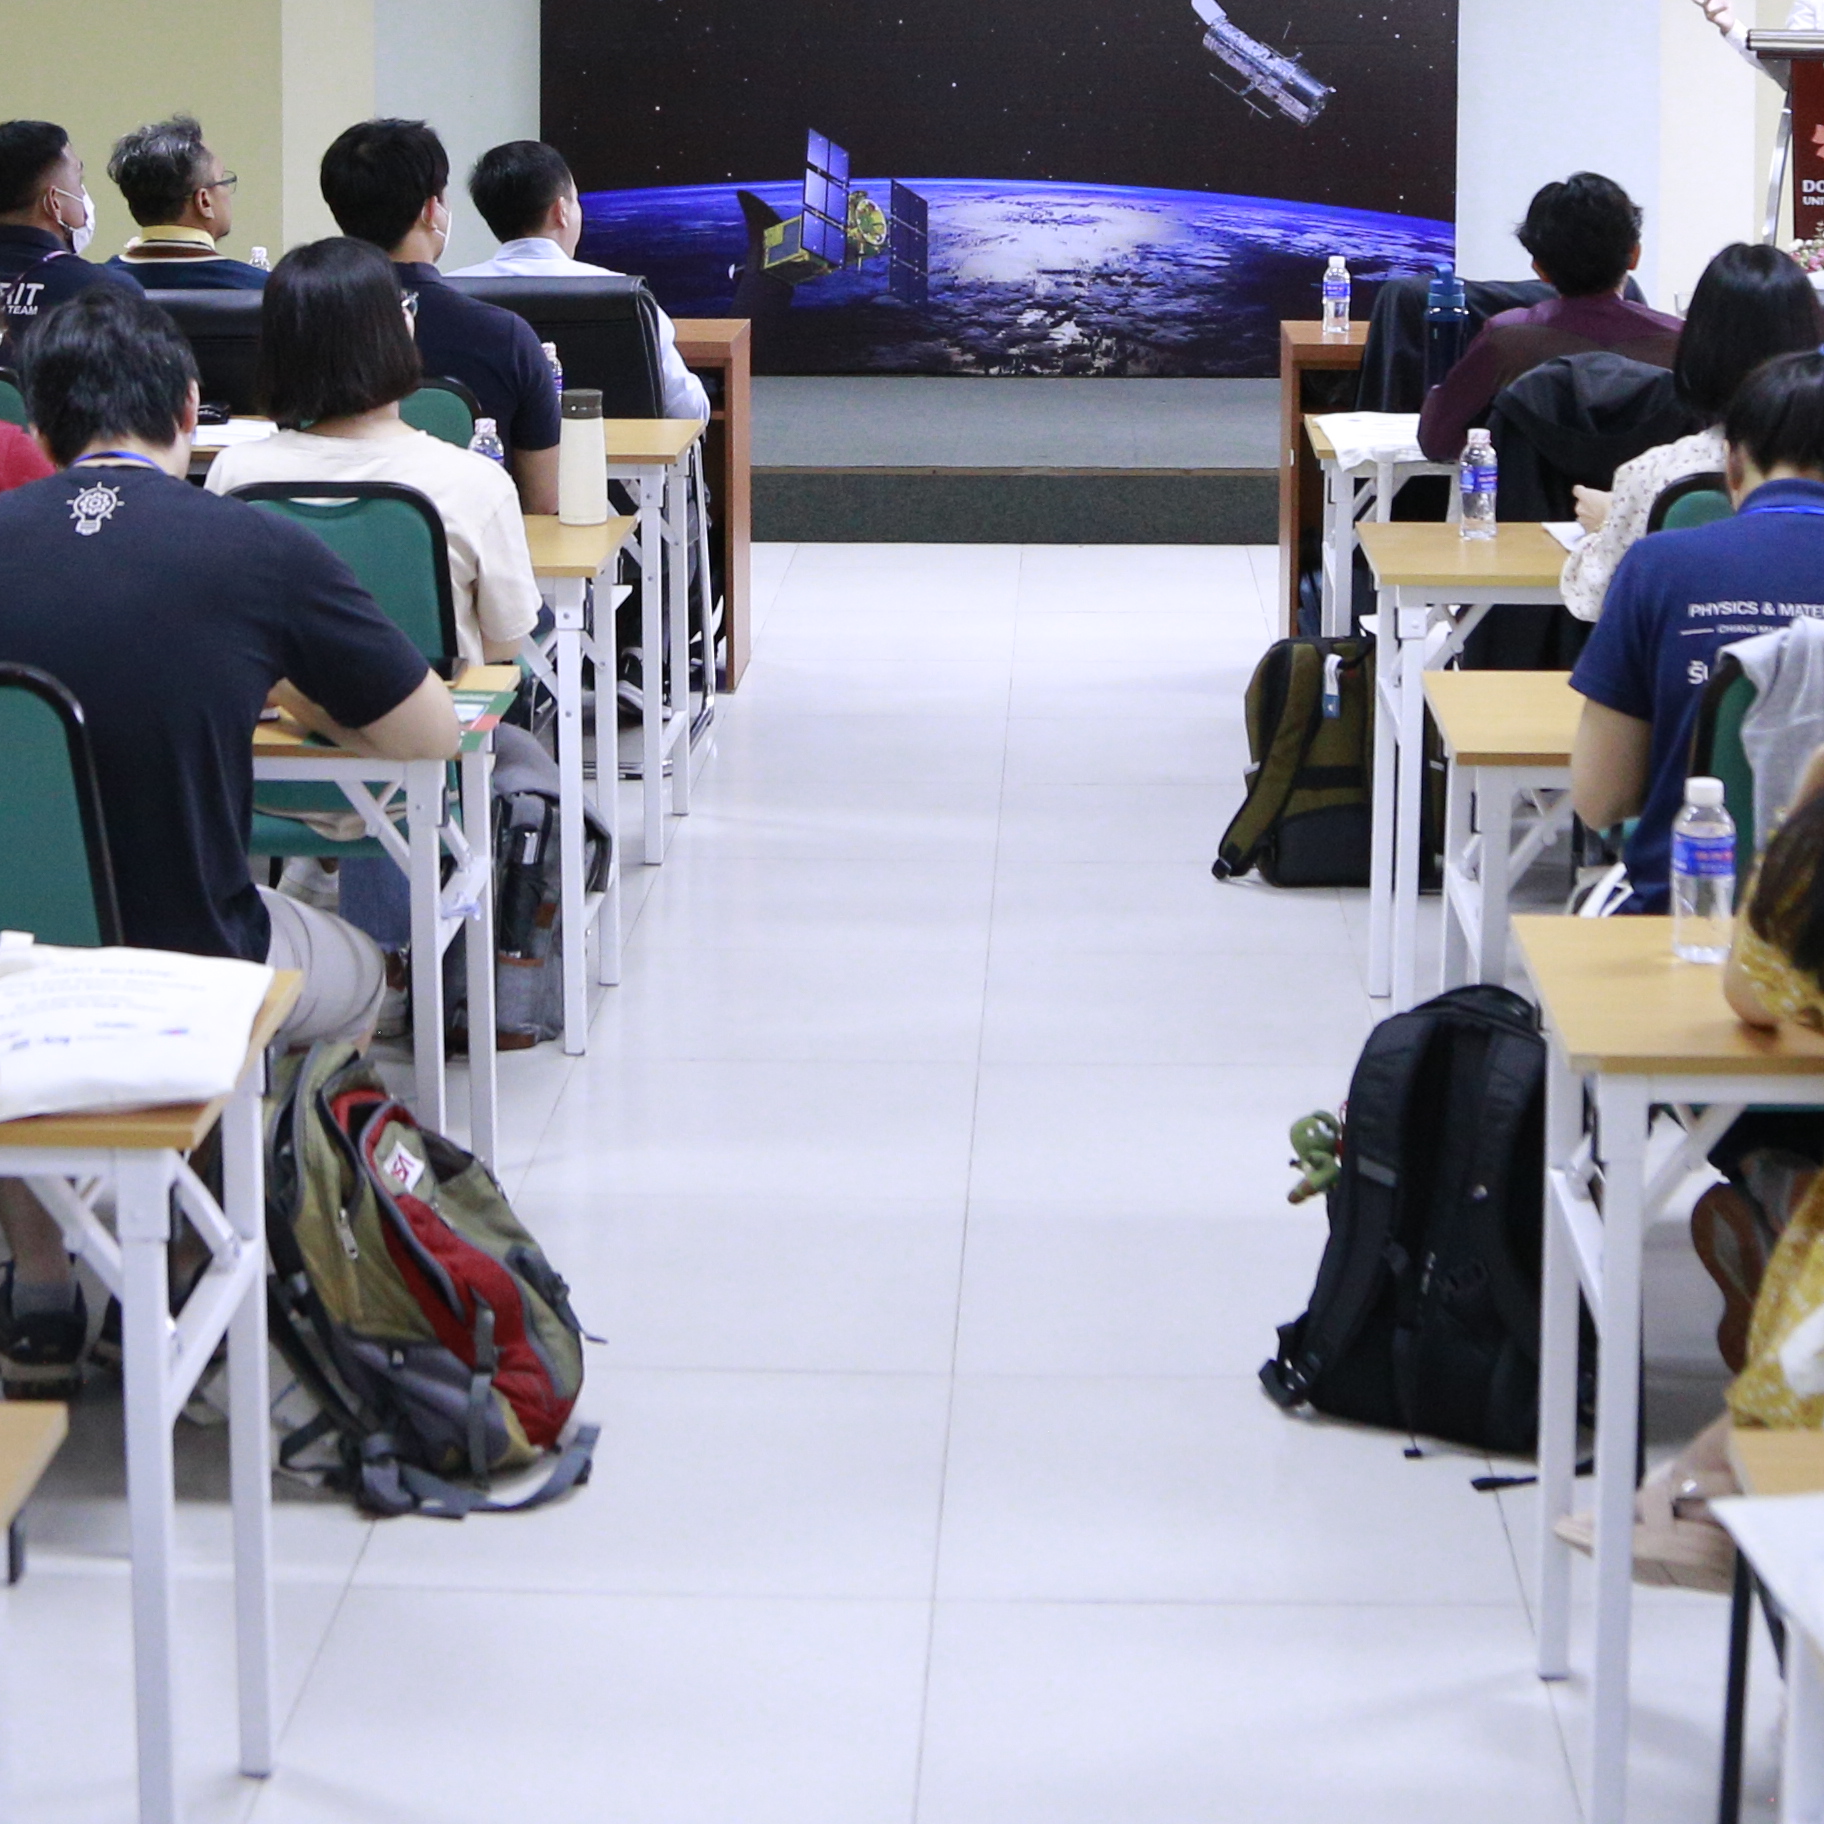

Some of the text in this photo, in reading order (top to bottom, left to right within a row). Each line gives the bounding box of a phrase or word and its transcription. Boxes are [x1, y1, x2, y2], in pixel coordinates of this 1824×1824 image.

[8, 305, 39, 315] TEAM
[1688, 600, 1759, 618] PHYSICS
[1760, 601, 1776, 616] &
